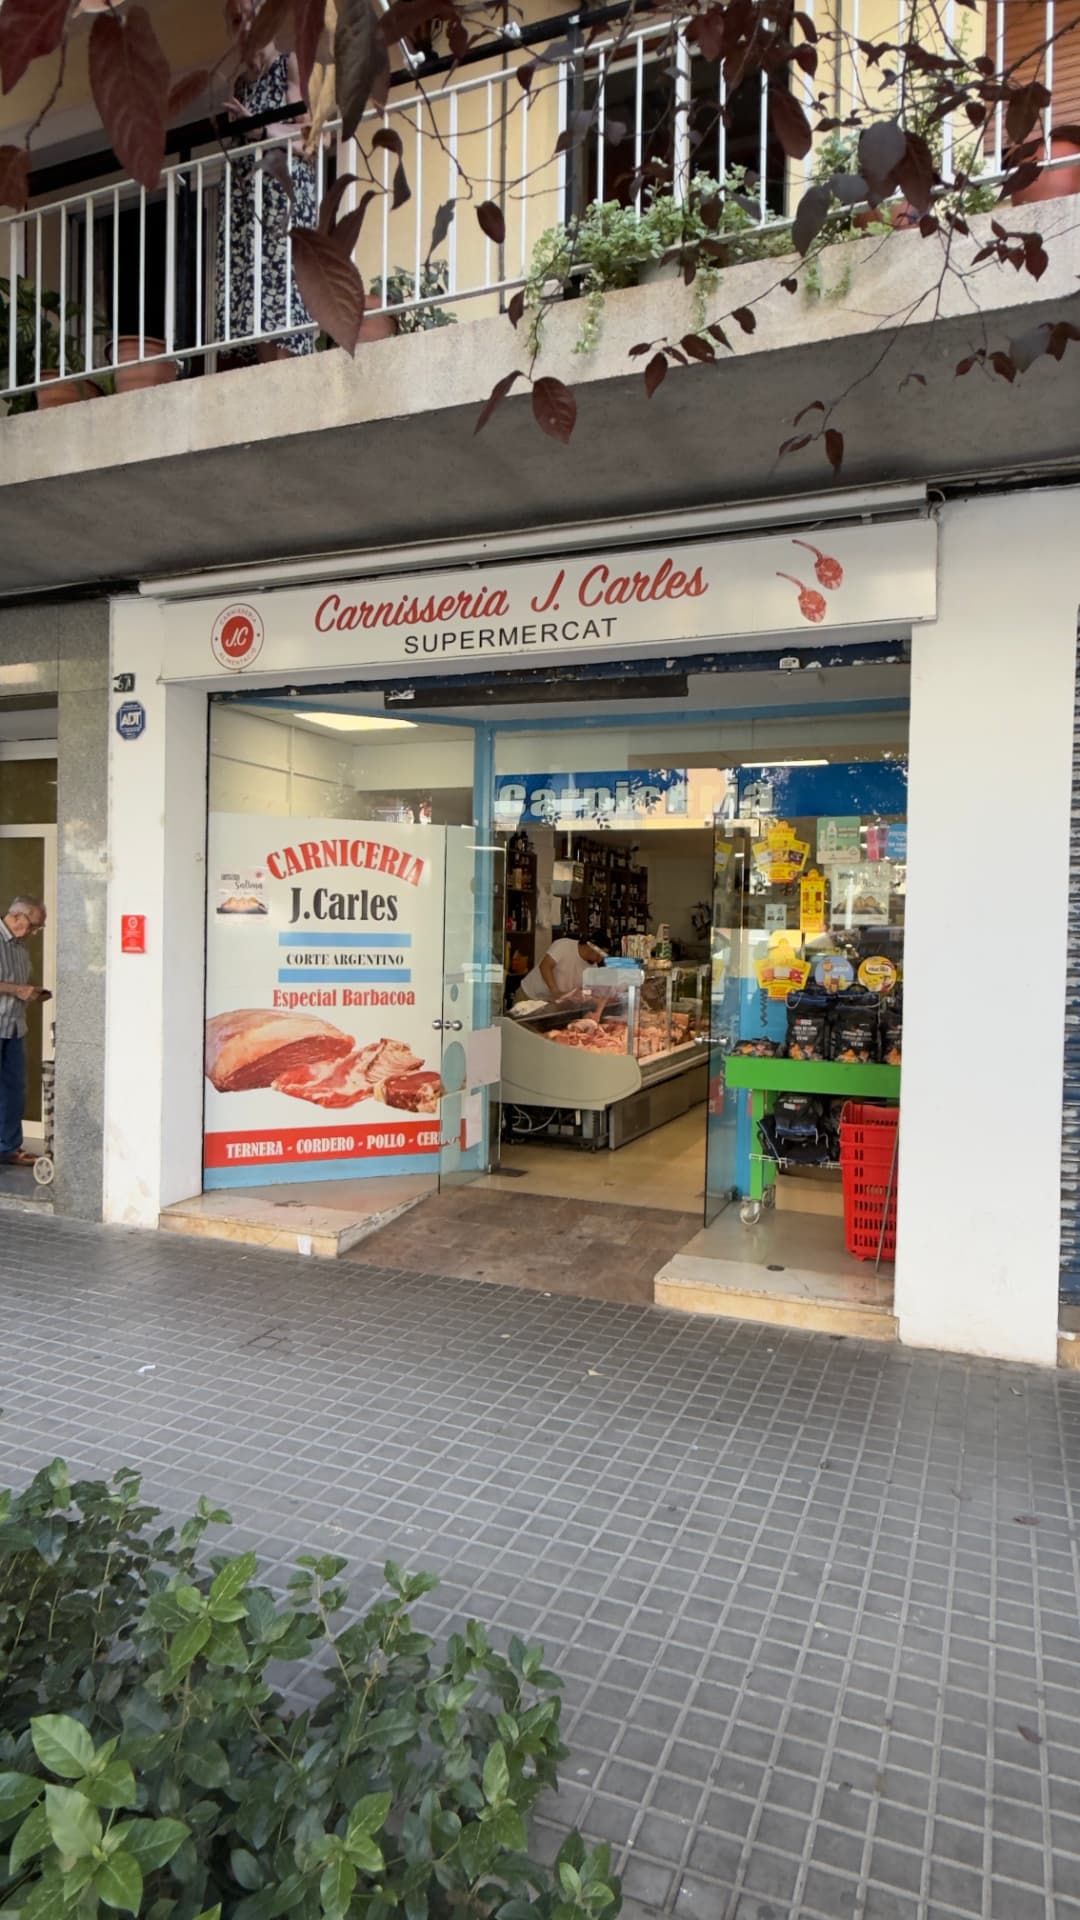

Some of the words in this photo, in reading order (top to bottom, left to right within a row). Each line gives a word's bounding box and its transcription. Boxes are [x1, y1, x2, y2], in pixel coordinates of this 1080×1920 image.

[314, 586, 509, 632] Carnisseria
[530, 568, 565, 612] J.
[578, 557, 709, 607] Carles
[403, 616, 618, 655] SUPERMERCAT
[121, 711, 141, 727] ADT
[266, 838, 425, 887] CARNICERIA
[286, 953, 330, 966] CORTE
[333, 953, 404, 966] ARGENTINO
[272, 989, 337, 1009] Especial
[342, 988, 416, 1007] Barbacoa
[226, 1140, 284, 1159] TERNERA
[296, 1136, 354, 1154] CORDERO
[367, 1132, 406, 1151] POLLO
